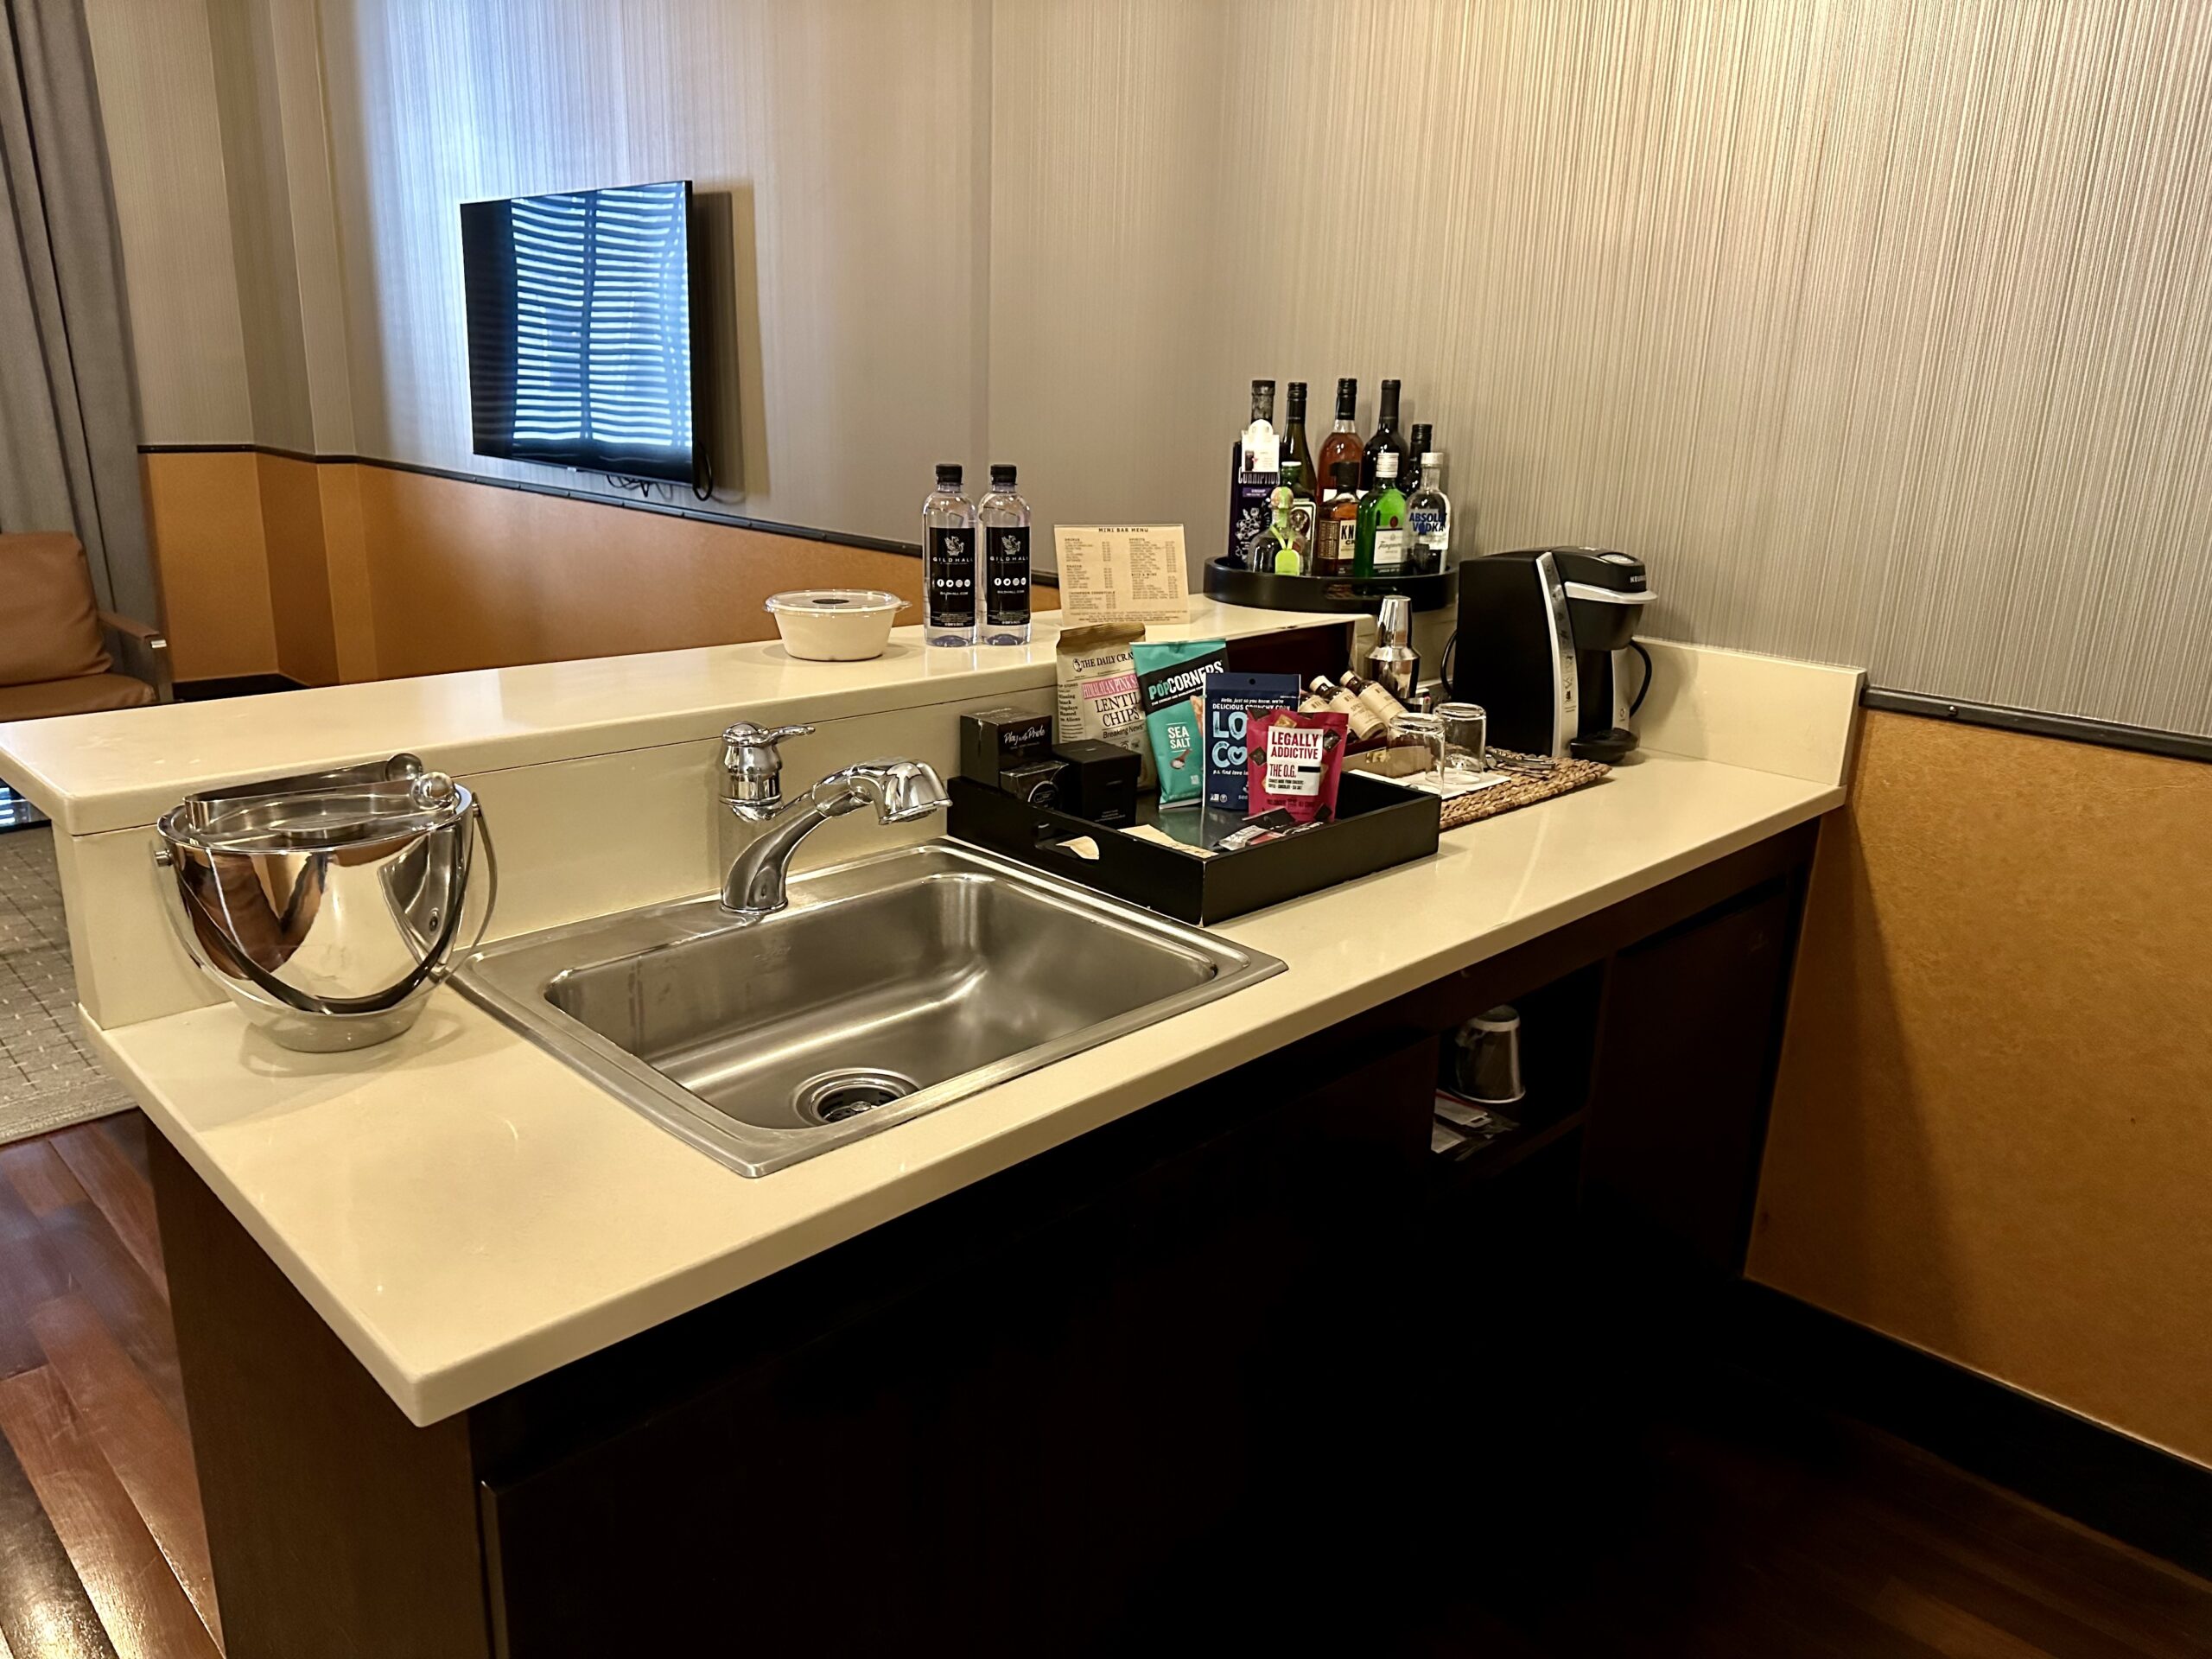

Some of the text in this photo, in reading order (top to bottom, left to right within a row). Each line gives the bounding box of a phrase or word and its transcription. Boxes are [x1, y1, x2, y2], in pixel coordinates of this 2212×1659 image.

[1413, 522, 1444, 534] VODKA
[1081, 658, 1095, 670] THE
[1096, 656, 1116, 667] DAILY
[1115, 676, 1130, 691] PINK
[1095, 691, 1141, 713] LENTIL
[1103, 707, 1140, 728] CHIPS
[1103, 724, 1144, 739] Breaking News
[1167, 726, 1190, 740] SEA
[1272, 731, 1319, 747] LEGALLY
[1169, 737, 1191, 751] SALT
[1271, 746, 1318, 760] ADDICTIVE
[1269, 764, 1297, 779] THE O.G.
